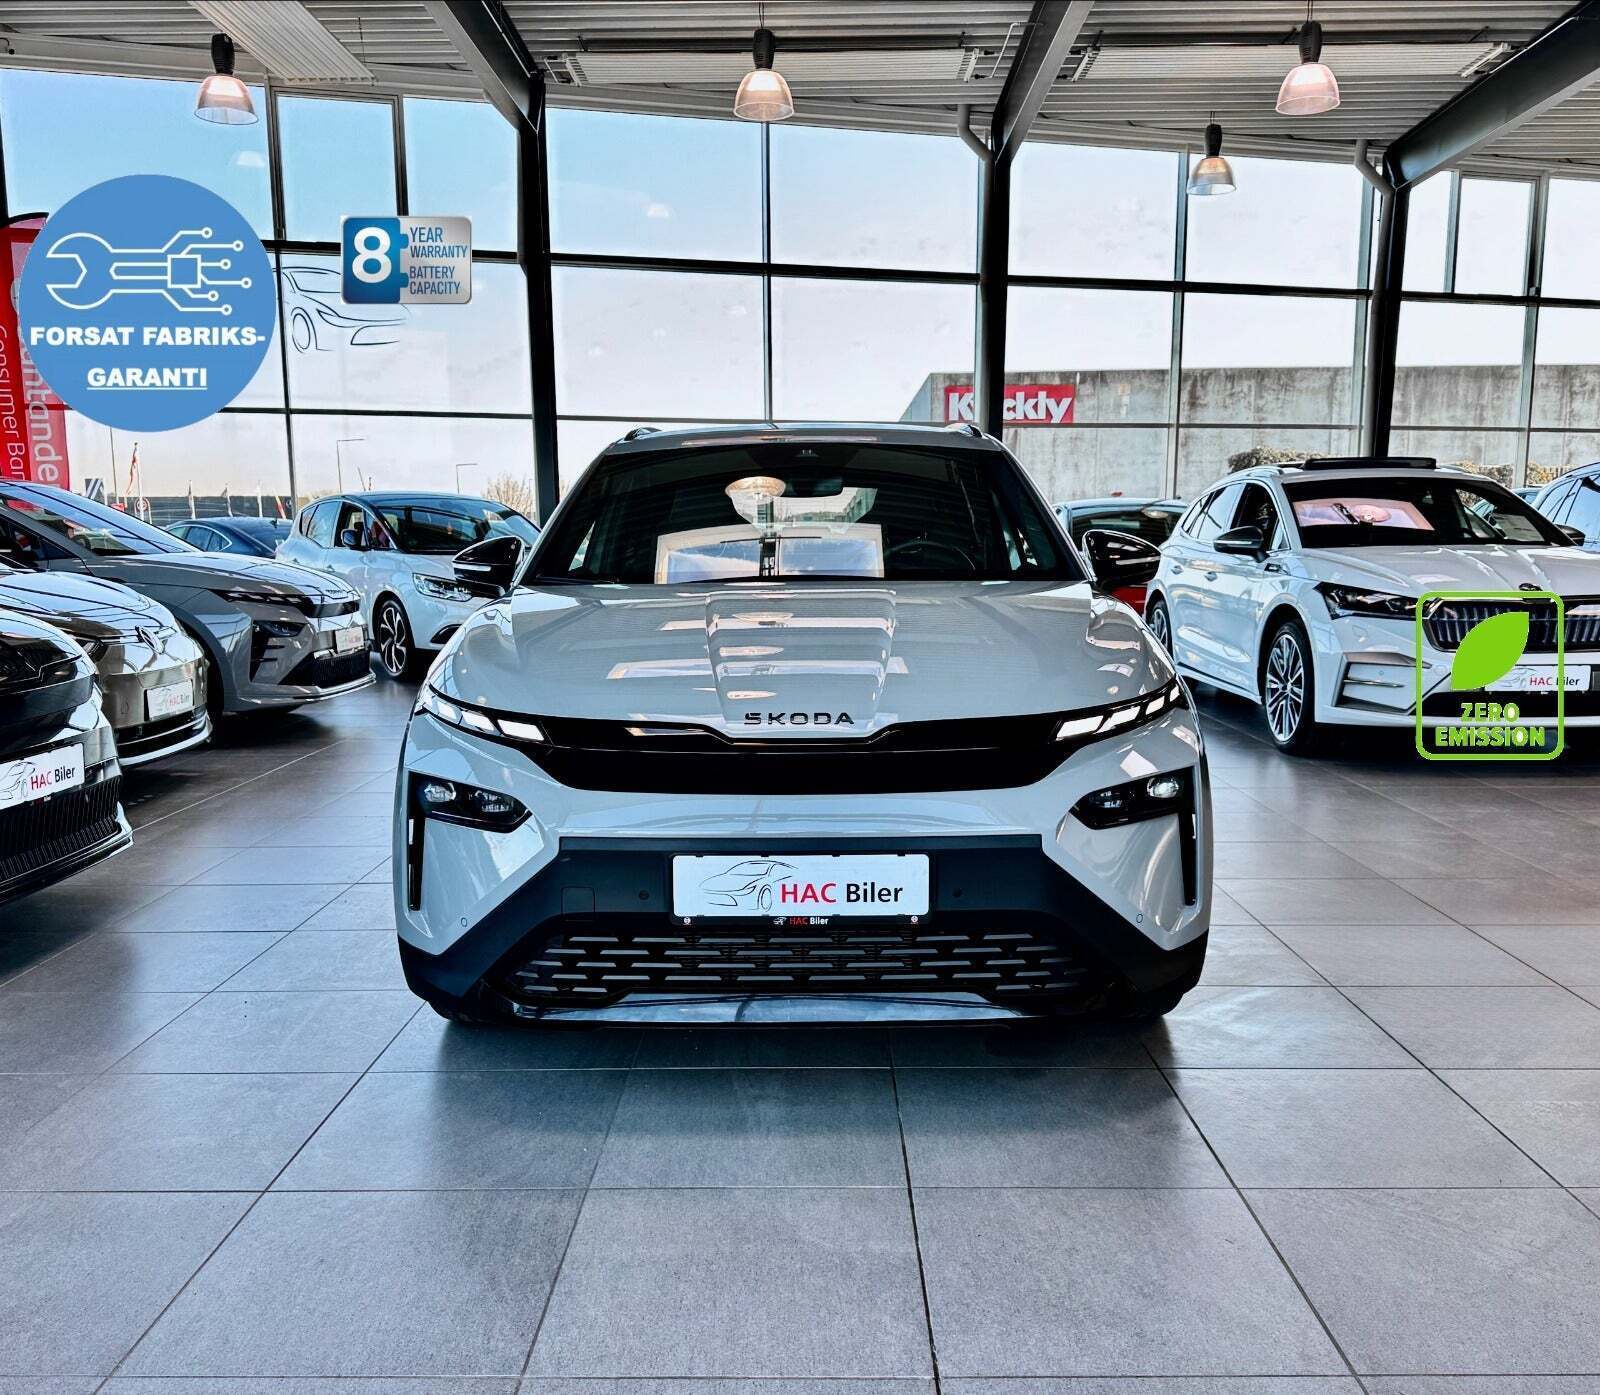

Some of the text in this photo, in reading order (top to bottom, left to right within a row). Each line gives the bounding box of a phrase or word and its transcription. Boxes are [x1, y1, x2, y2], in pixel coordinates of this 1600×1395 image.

[948, 390, 1072, 424] Kckly
[1529, 676, 1580, 686] HAC iler
[743, 712, 854, 725] SKODA
[30, 765, 76, 790] HAC Biler
[781, 881, 904, 903] HAC Biler
[789, 917, 829, 925] HAC Biler
